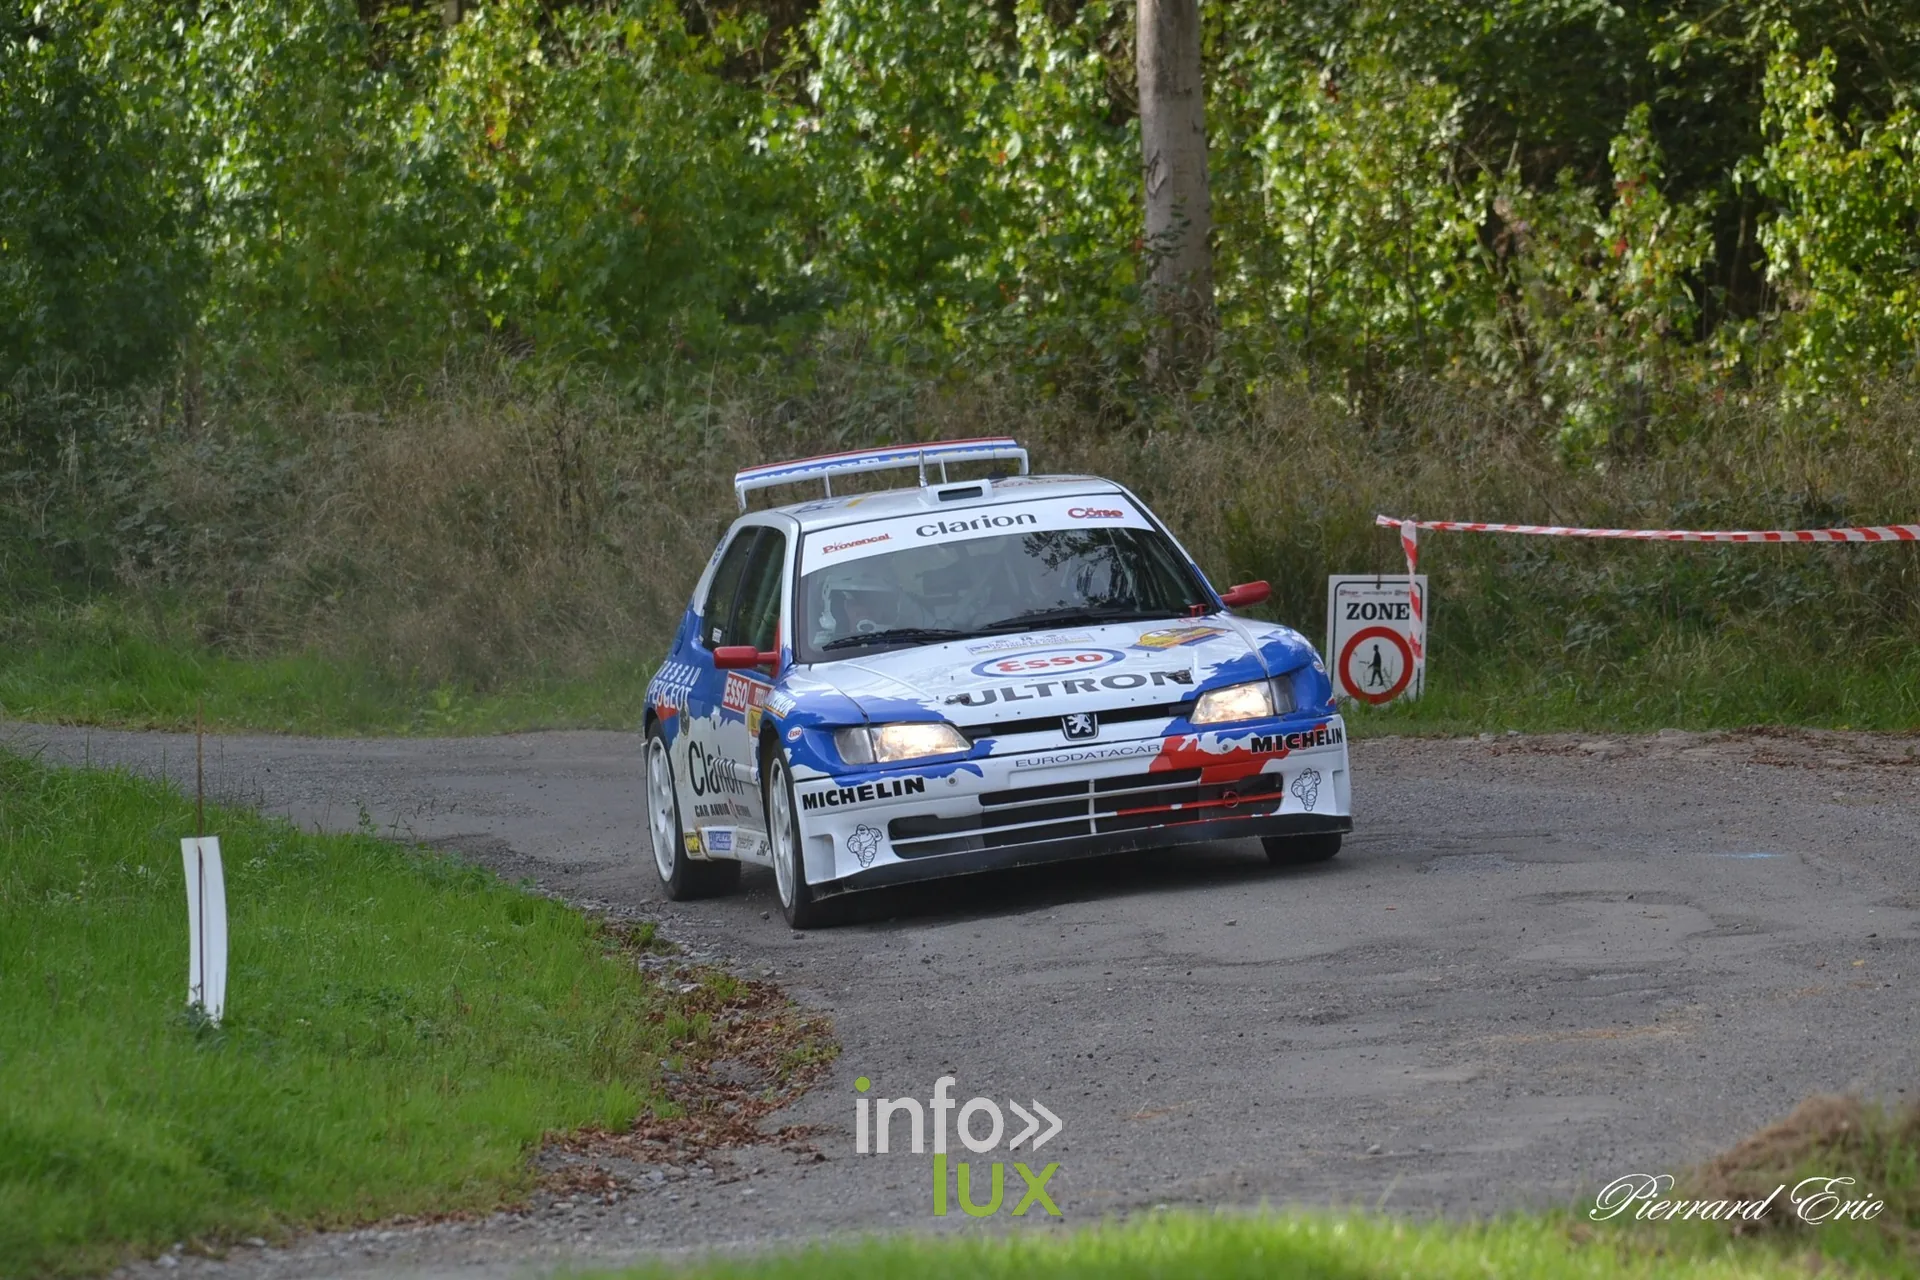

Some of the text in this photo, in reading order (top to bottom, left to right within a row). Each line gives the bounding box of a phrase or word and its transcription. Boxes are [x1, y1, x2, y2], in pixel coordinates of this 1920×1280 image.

[1346, 602, 1410, 620] ZONE
[647, 679, 693, 712] PEUGEOT
[724, 677, 748, 709] ESSO
[958, 669, 1195, 707] ULTRON
[1015, 744, 1161, 768] EURODATACAR
[1250, 727, 1343, 754] MICHELIN
[802, 777, 926, 811] MICHELIN
